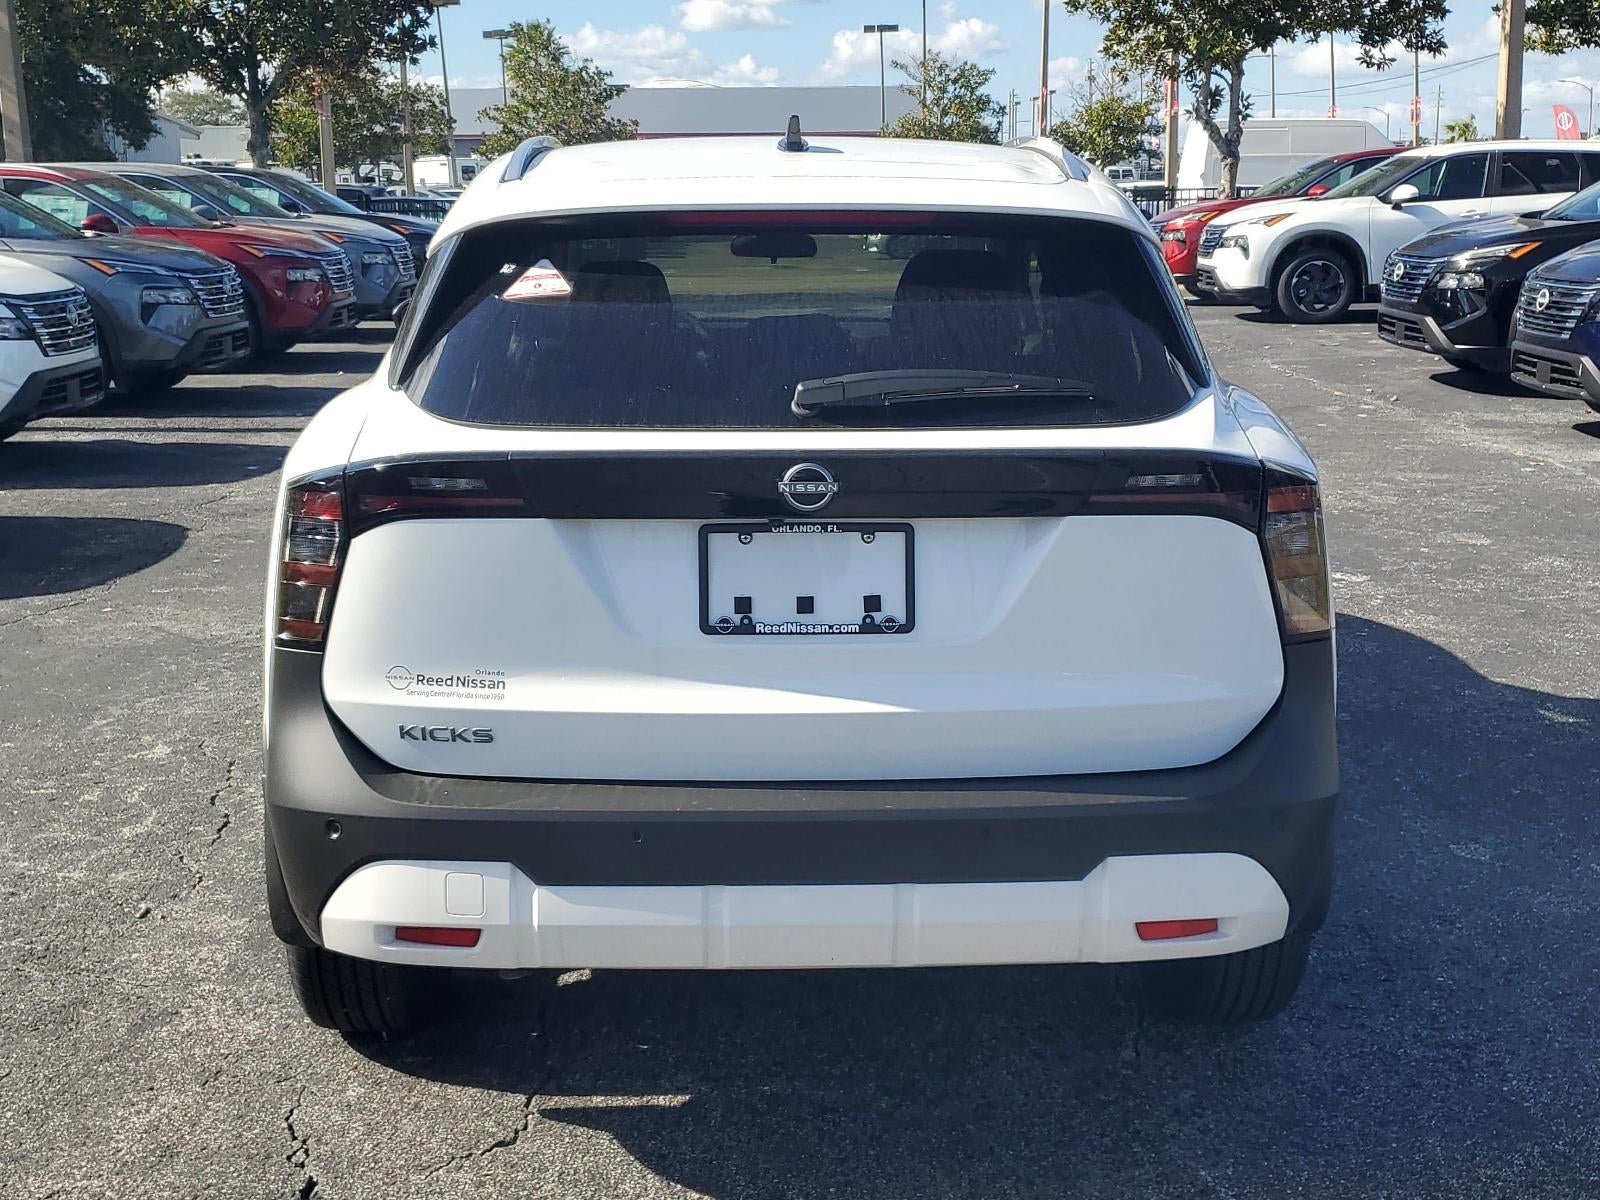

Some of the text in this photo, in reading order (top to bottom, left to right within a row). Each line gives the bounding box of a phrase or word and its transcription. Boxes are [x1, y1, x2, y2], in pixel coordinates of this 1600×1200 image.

[780, 484, 837, 492] NISSAN
[771, 525, 843, 534] ORLANDO, FL.
[755, 623, 860, 634] ReedNissan.com
[475, 669, 505, 677] Orlando
[416, 674, 506, 690] Reed Nissan
[406, 689, 505, 701] Serving Central Florida since 1950
[398, 723, 494, 744] KICKS
